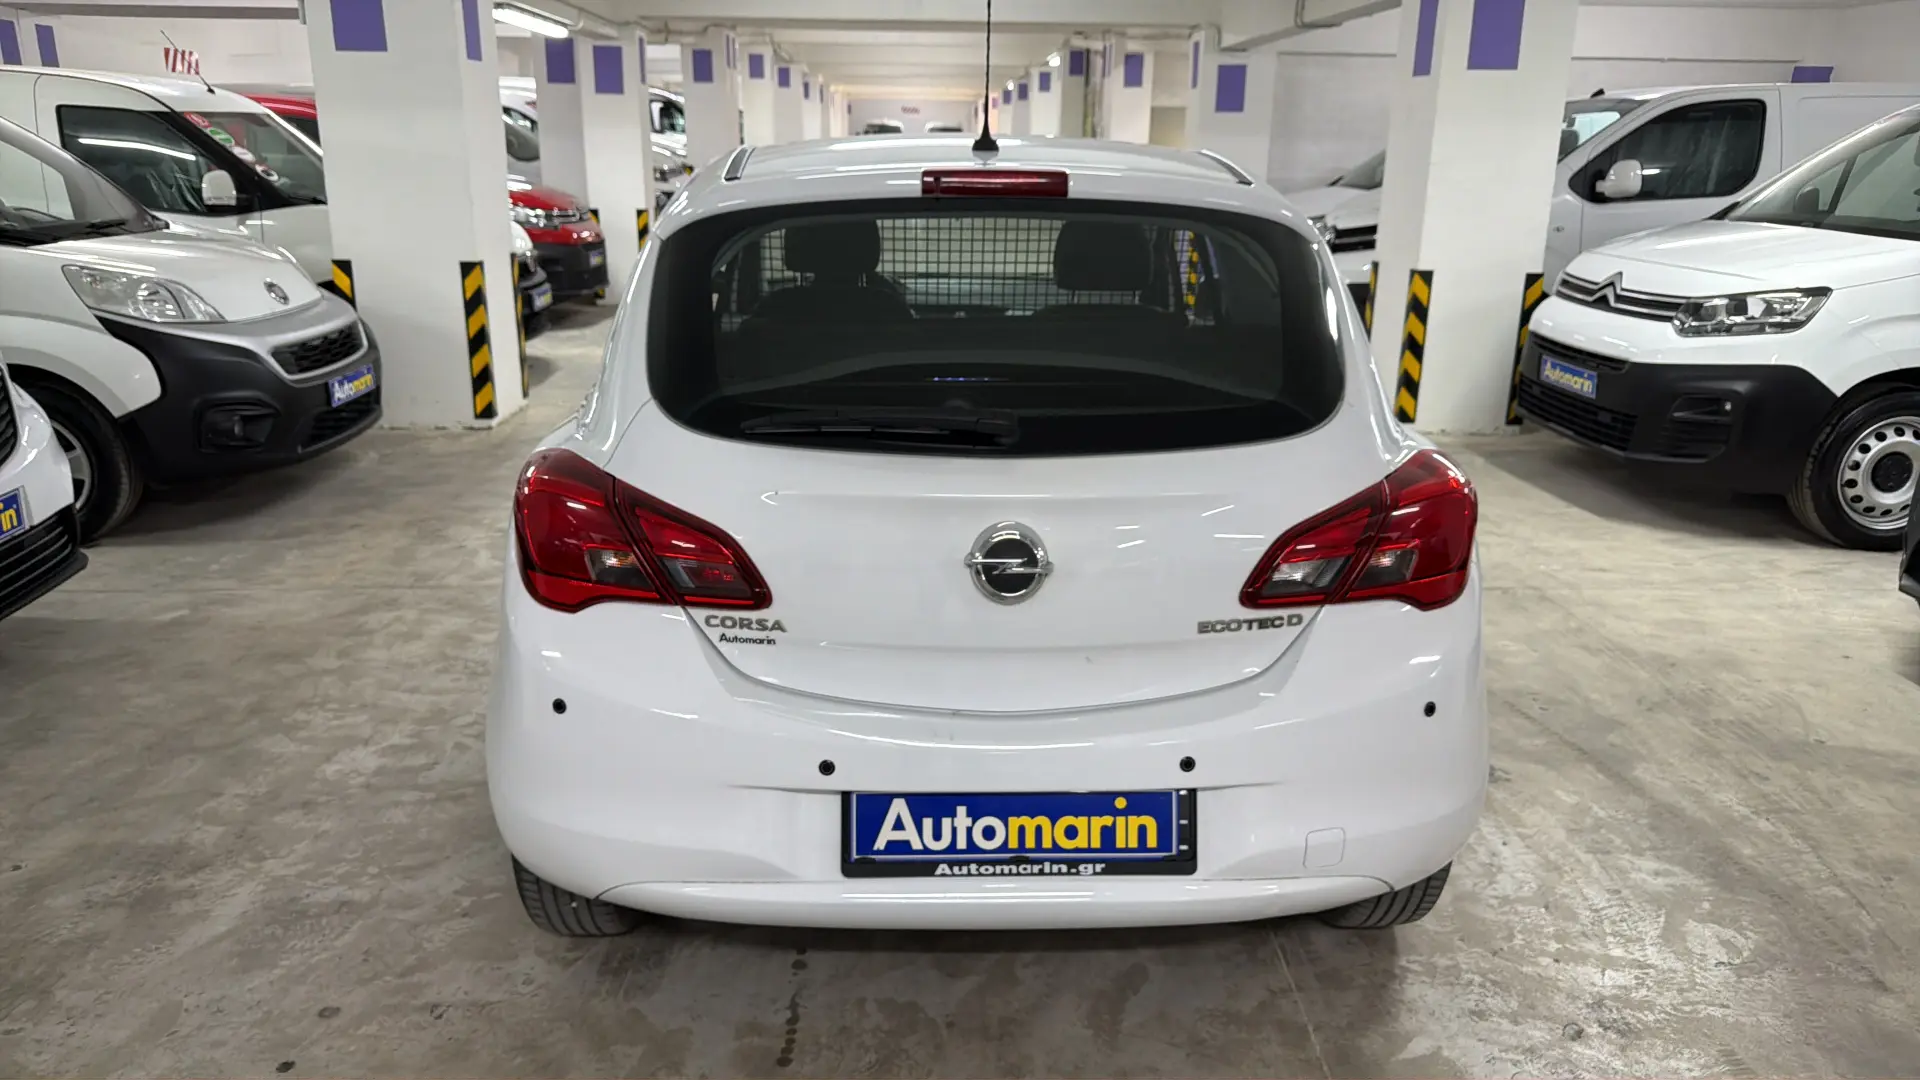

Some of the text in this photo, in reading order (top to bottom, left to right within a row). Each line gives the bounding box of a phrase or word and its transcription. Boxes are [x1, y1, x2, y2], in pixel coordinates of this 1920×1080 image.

[333, 365, 374, 400] Automarin
[1544, 360, 1592, 392] Automarin
[704, 614, 788, 633] CORSA
[719, 632, 776, 645] Automarin
[873, 796, 1157, 851] Automarin
[934, 862, 1106, 876] Automarin.gr
